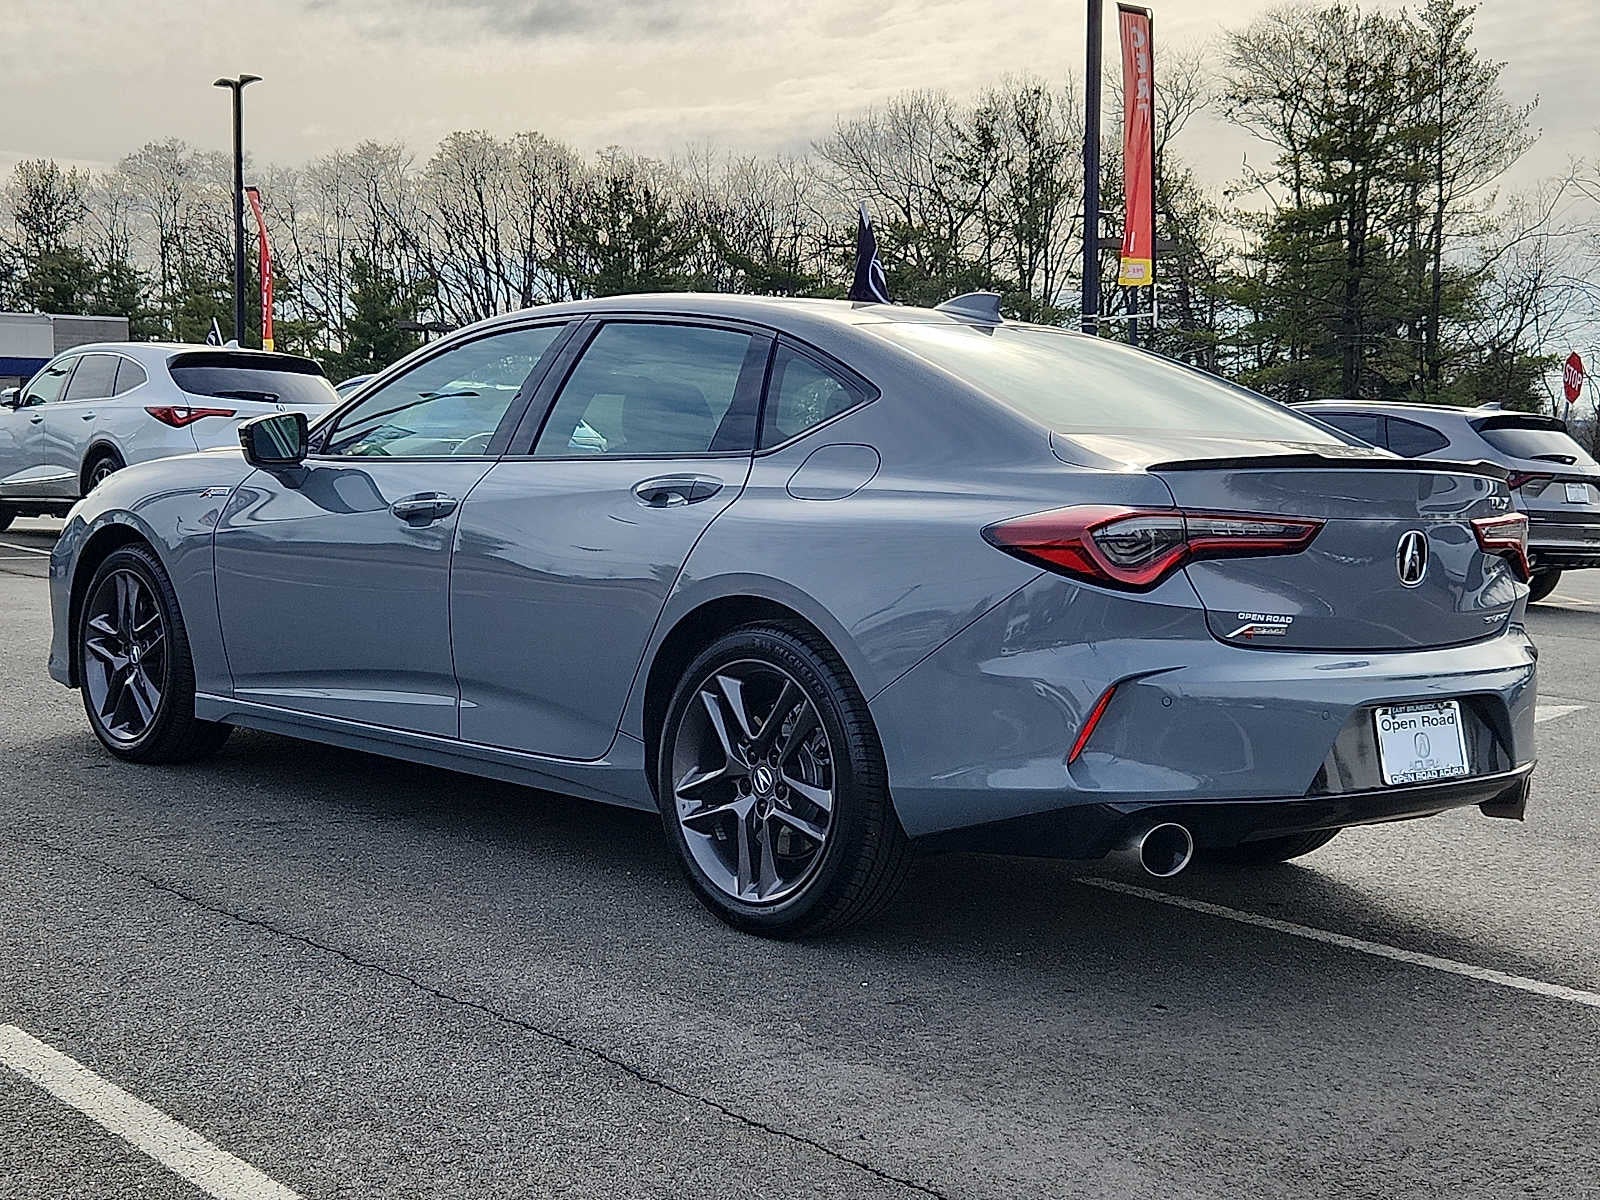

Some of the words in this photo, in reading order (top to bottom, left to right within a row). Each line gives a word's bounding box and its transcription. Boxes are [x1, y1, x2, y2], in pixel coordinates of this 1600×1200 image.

[1565, 363, 1582, 391] STOP
[1237, 612, 1265, 621] OPEN
[1265, 614, 1294, 624] ROAD
[1381, 718, 1417, 734] Open
[1421, 713, 1455, 727] Road
[1392, 774, 1415, 784] OPEN
[1415, 770, 1438, 780] ROAD
[1439, 766, 1464, 777] ACURA
